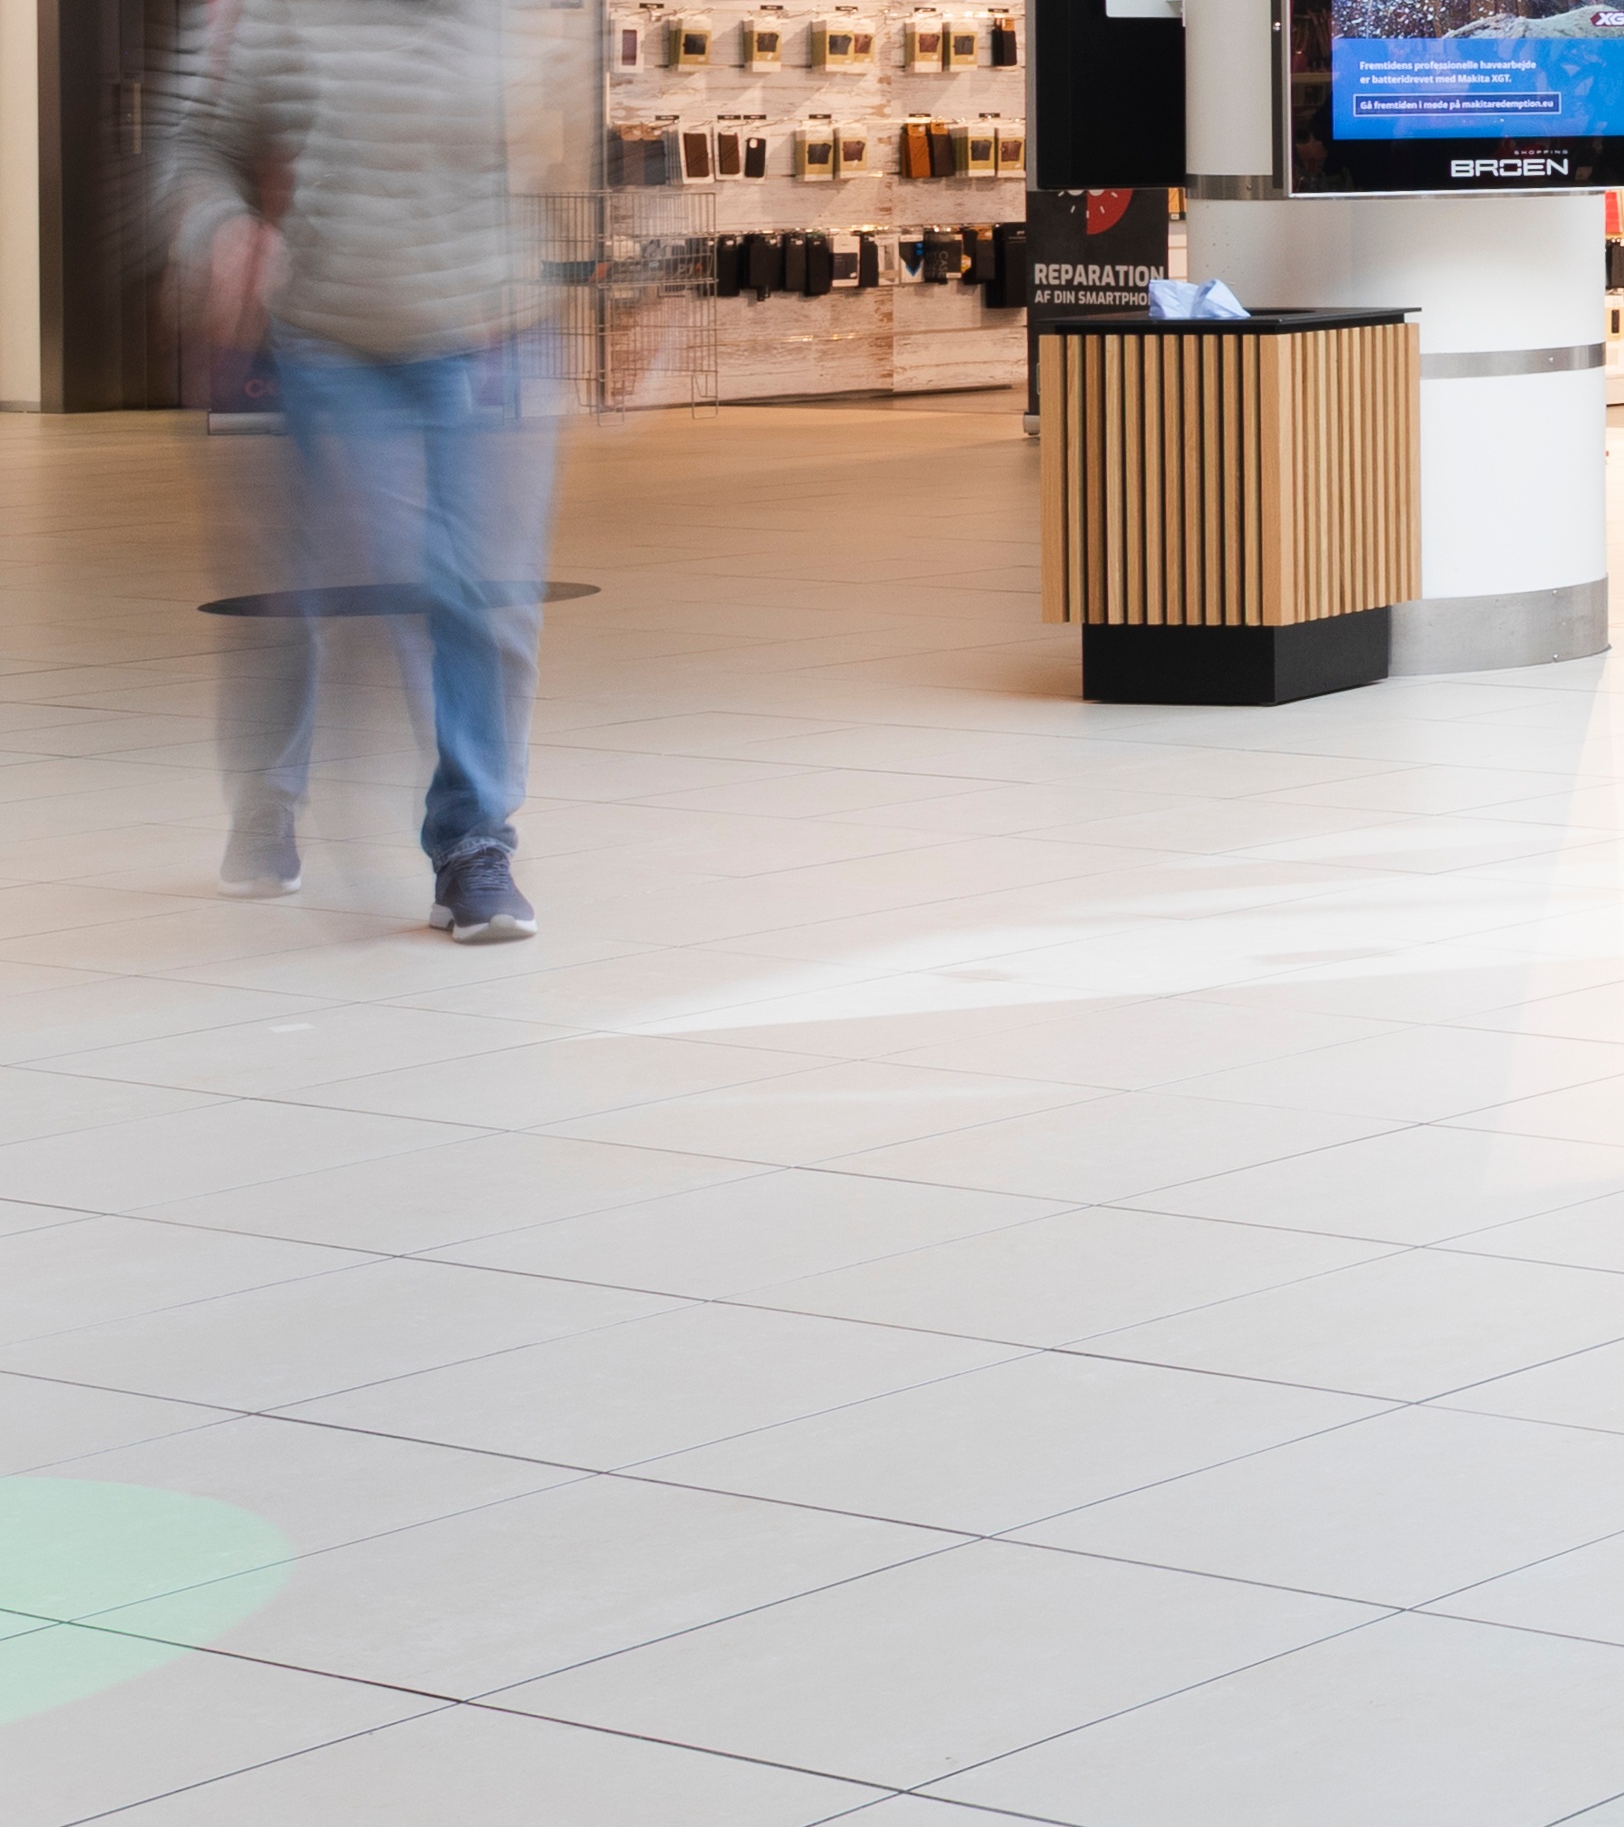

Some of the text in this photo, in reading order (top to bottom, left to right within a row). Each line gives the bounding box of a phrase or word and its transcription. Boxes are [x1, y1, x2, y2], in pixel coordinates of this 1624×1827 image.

[1360, 60, 1537, 73] Fremtidens professionelle havearbejde
[1360, 74, 1512, 84] er batteridrevet med Makita XGT.
[1360, 98, 1554, 112] Gå fremtiden møde på makitaredemption.eu
[1451, 158, 1569, 177] BROEN
[1034, 263, 1164, 286] REPARATION
[1034, 290, 1149, 306] AF DIN SMARTPHO
